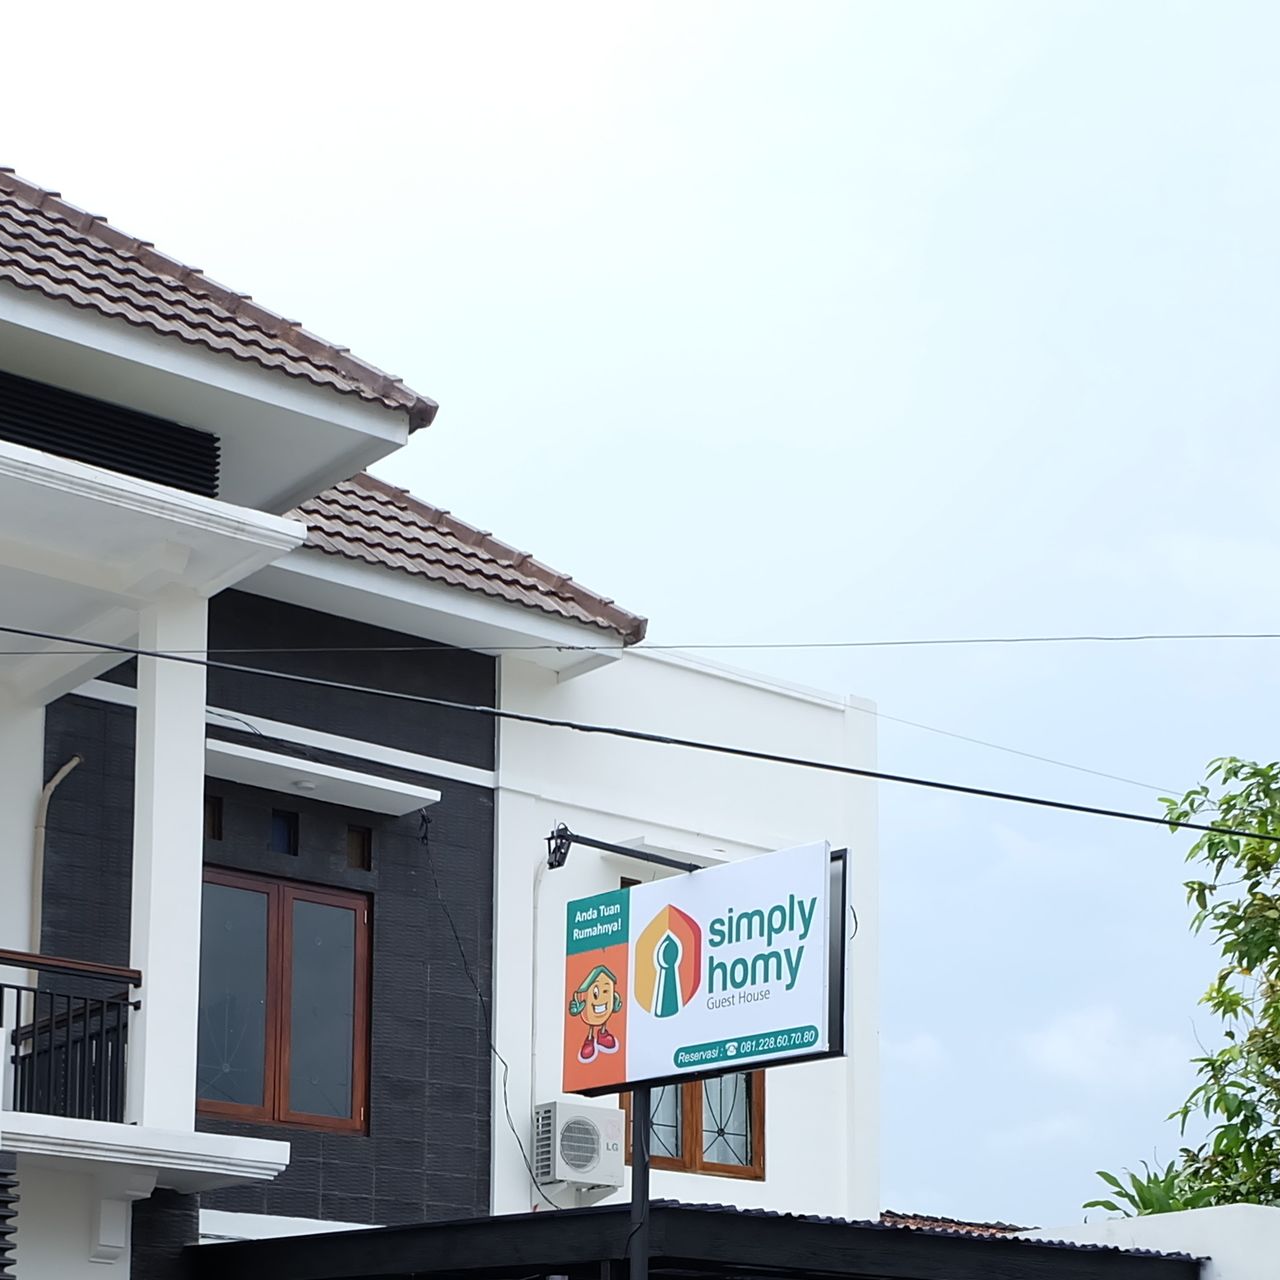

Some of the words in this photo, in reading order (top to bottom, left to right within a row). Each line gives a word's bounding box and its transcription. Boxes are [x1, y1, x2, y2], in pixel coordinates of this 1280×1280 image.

[575, 907, 598, 923] Anda
[599, 904, 620, 917] Tuan
[708, 894, 818, 948] simply
[573, 918, 622, 940] Rumahnya!
[708, 945, 805, 994] homy
[706, 994, 736, 1010] Guest
[738, 989, 771, 1005] House
[740, 1030, 816, 1053] 081.228.60.70.80
[606, 1142, 619, 1152] LG
